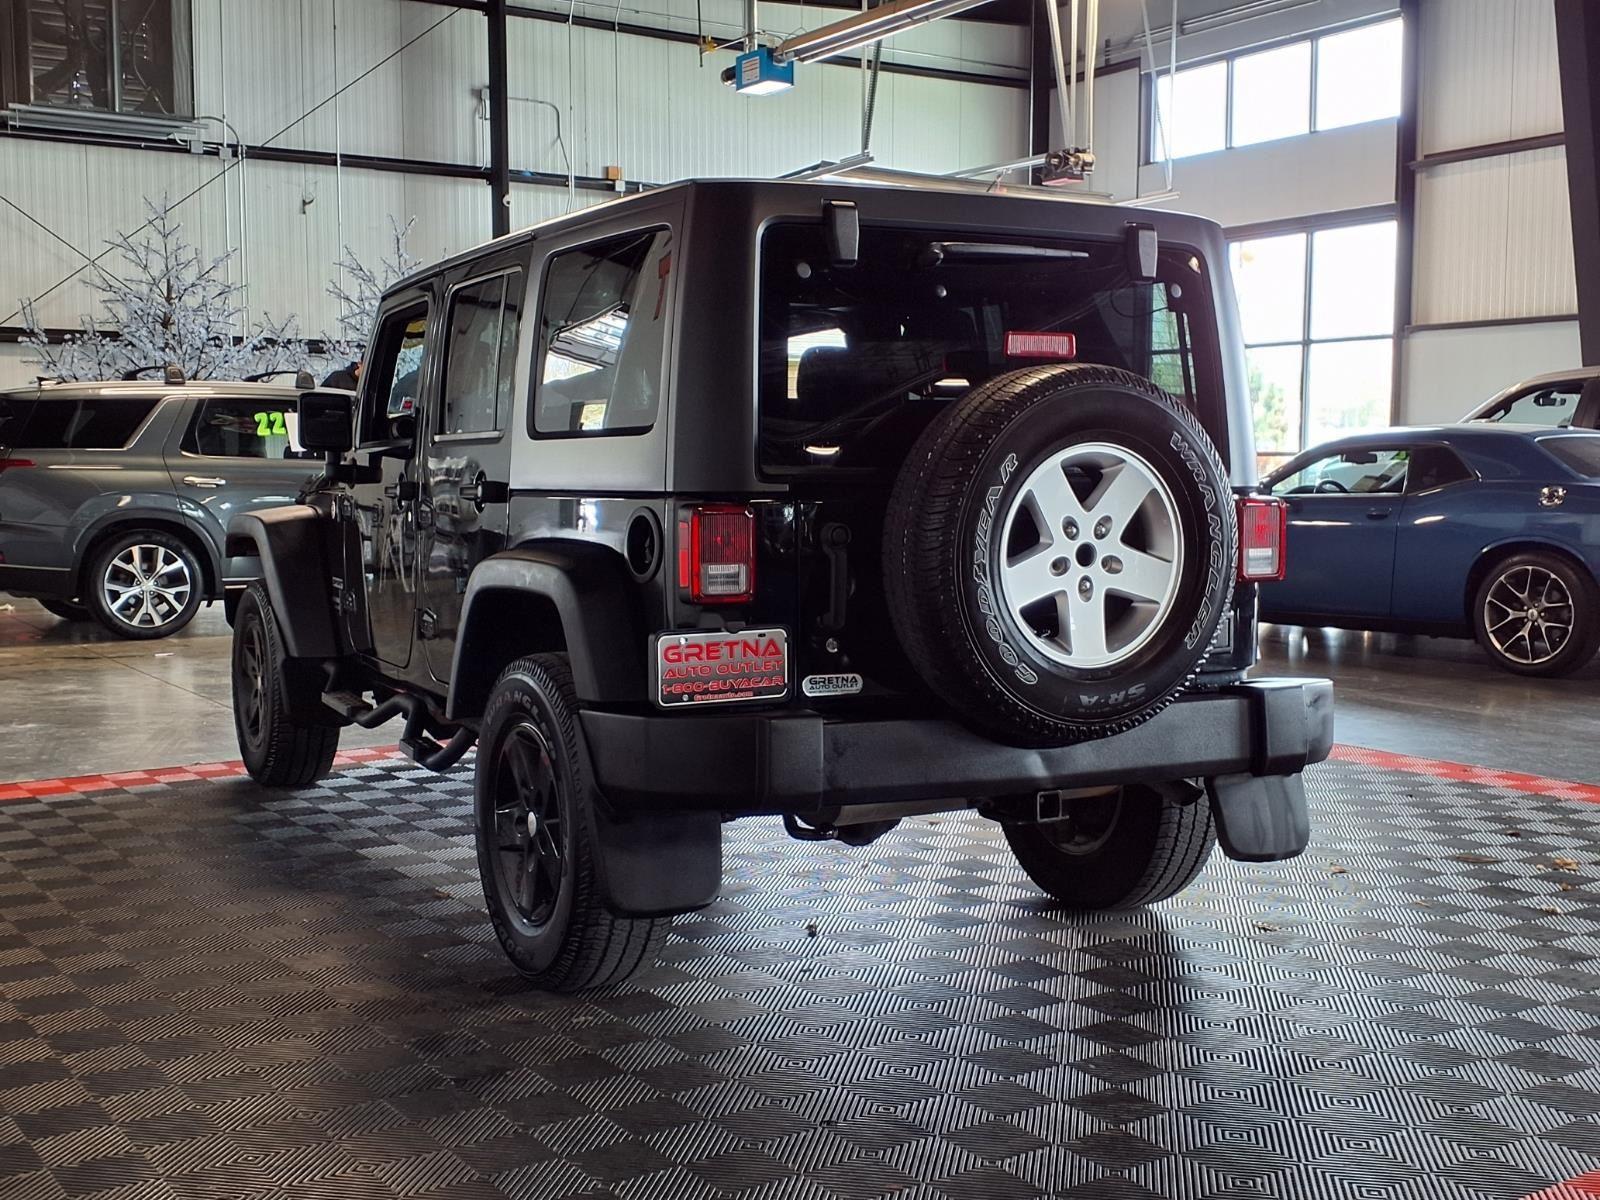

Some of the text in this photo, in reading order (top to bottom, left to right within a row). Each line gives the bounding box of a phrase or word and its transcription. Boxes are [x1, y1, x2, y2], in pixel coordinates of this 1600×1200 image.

[254, 411, 286, 437] 22
[1170, 431, 1222, 650] WRANGLER
[973, 453, 1038, 685] GOODYEAR
[663, 638, 783, 664] GRETNA
[664, 660, 784, 679] AUTO OUTLET
[808, 675, 859, 685] GRETNA
[662, 676, 785, 695] 1-800-BUYACAR
